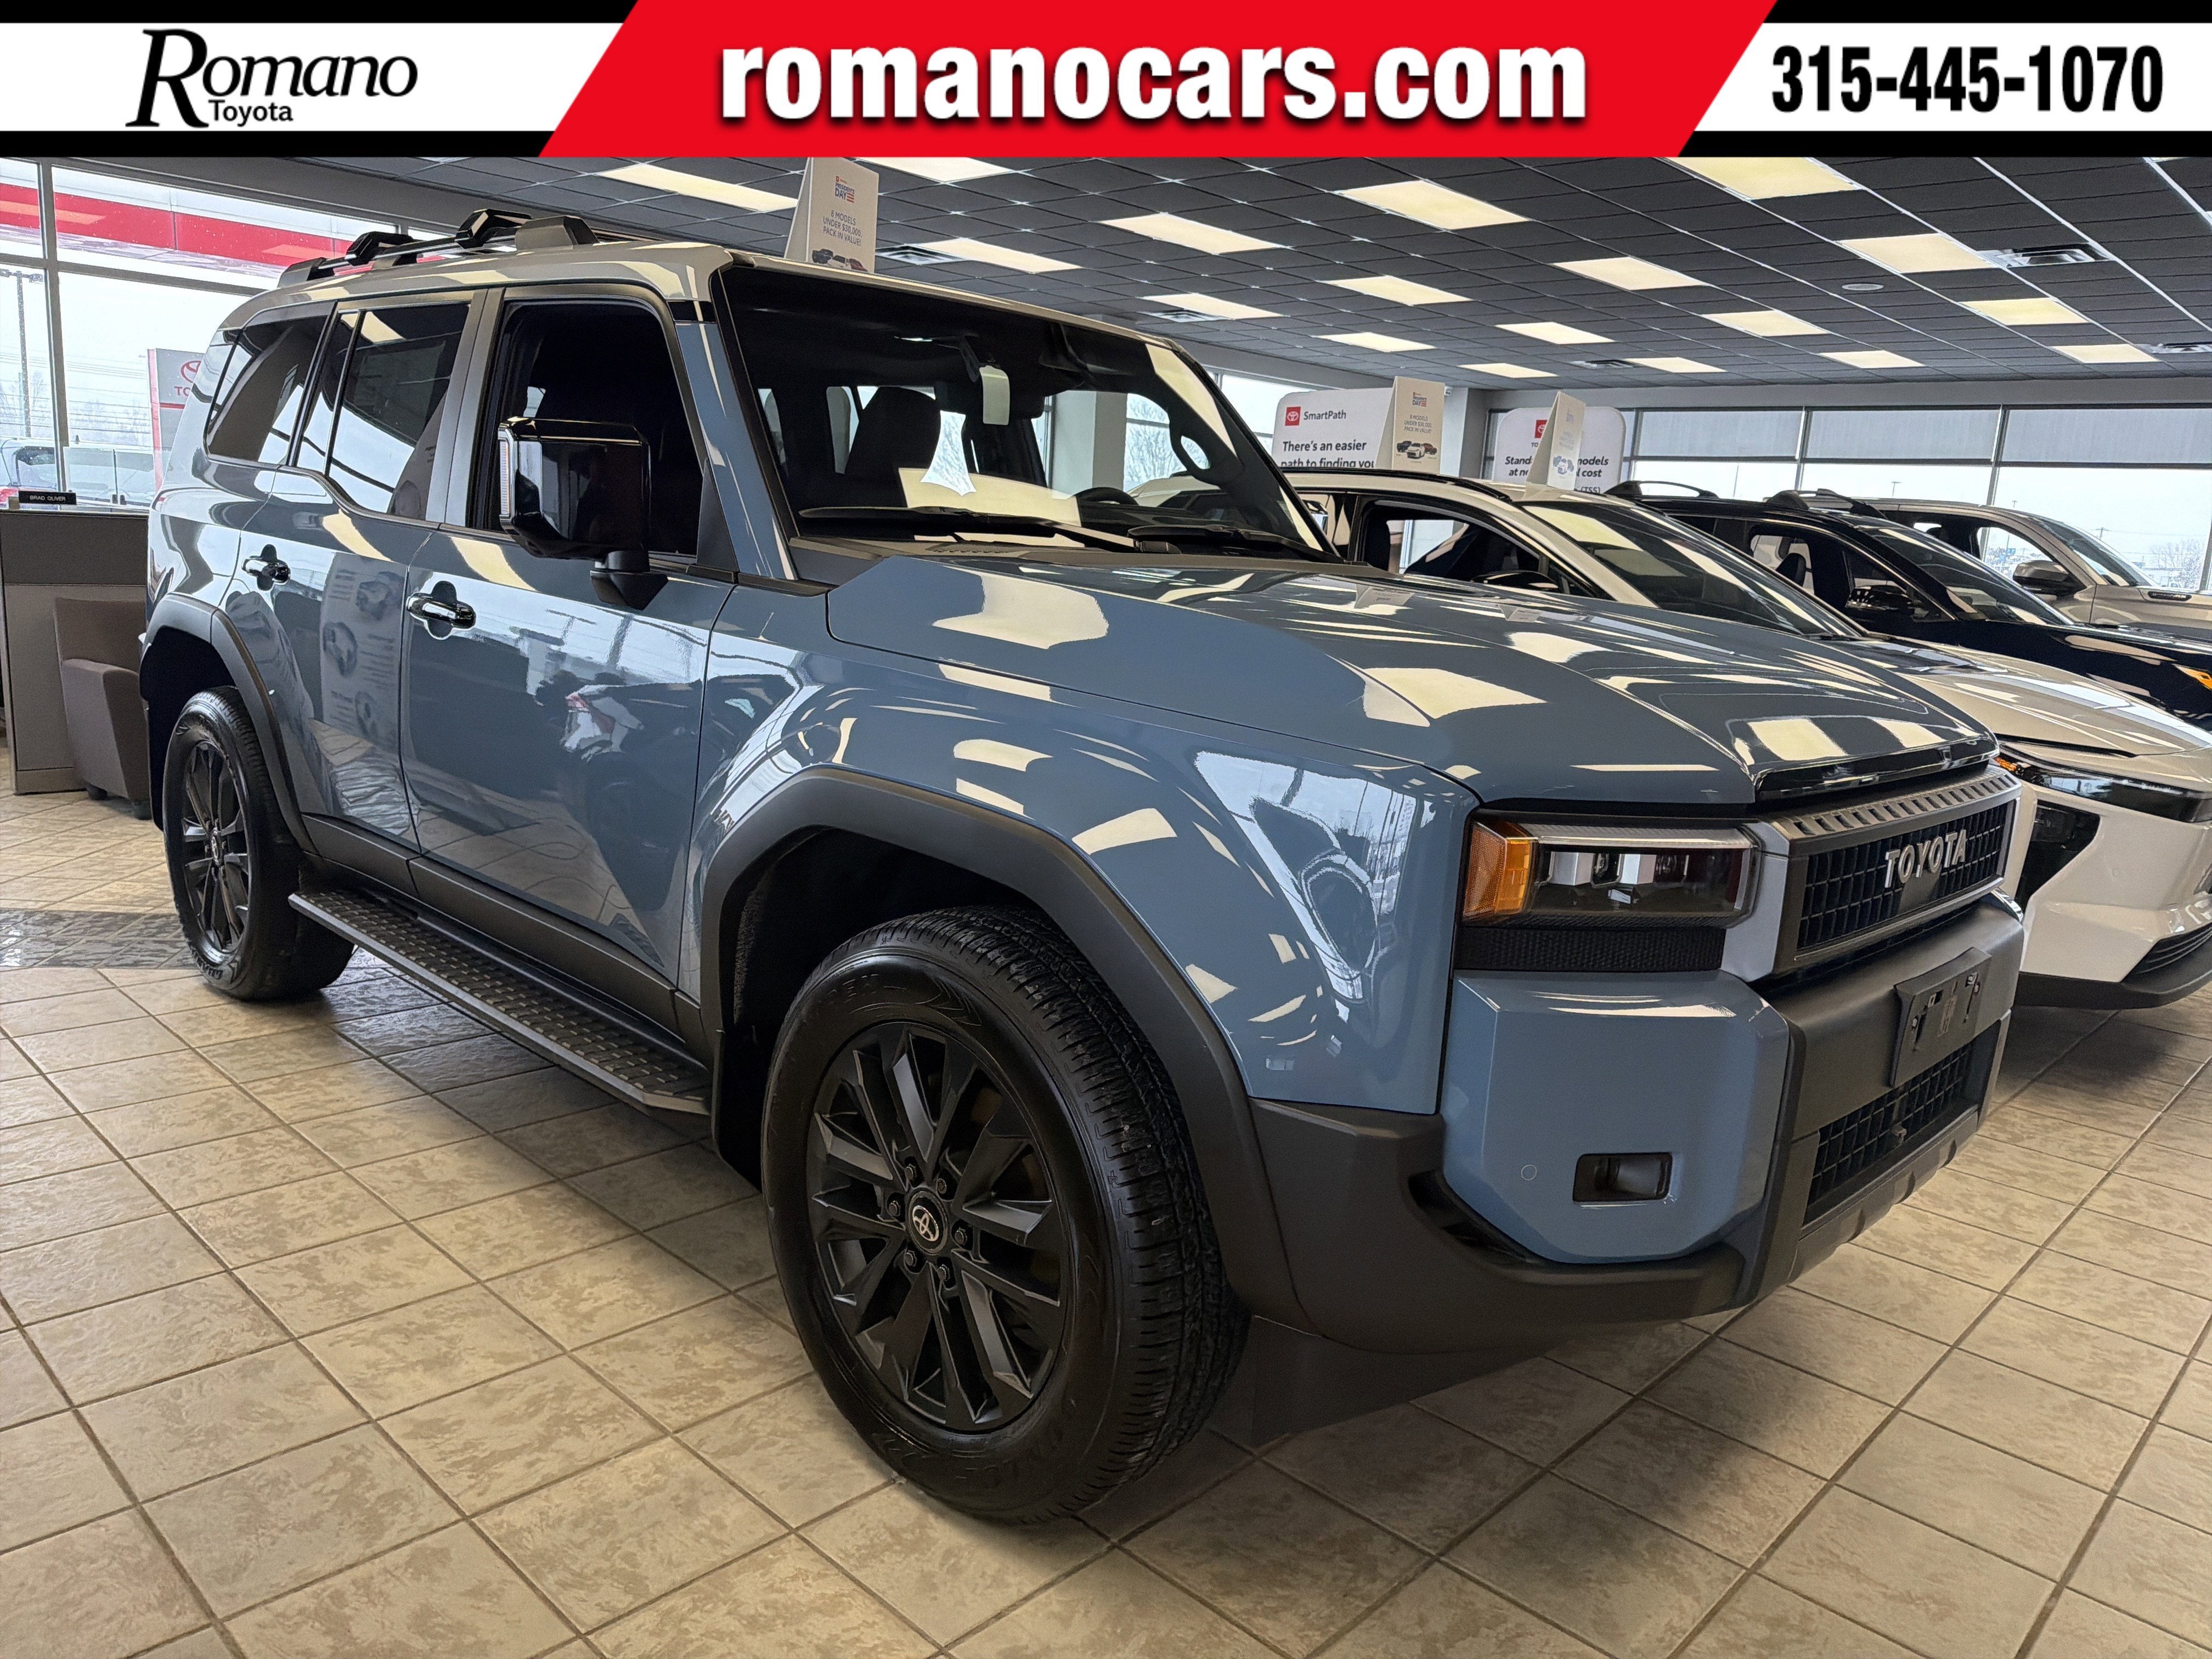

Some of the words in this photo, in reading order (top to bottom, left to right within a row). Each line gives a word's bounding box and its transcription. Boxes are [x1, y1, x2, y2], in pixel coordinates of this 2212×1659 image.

[834, 187, 847, 200] DAY
[823, 216, 841, 229] UNDER
[835, 212, 856, 226] MODELS
[823, 225, 836, 238] PACK
[837, 231, 843, 240] IN
[1303, 409, 1347, 421] SmartPath
[1319, 442, 1333, 451] an
[1335, 439, 1367, 451] easier
[1504, 455, 1533, 465] Stand
[1509, 468, 1518, 476] at
[1582, 469, 1602, 477] cost
[1885, 829, 1967, 888] TOYOTA
